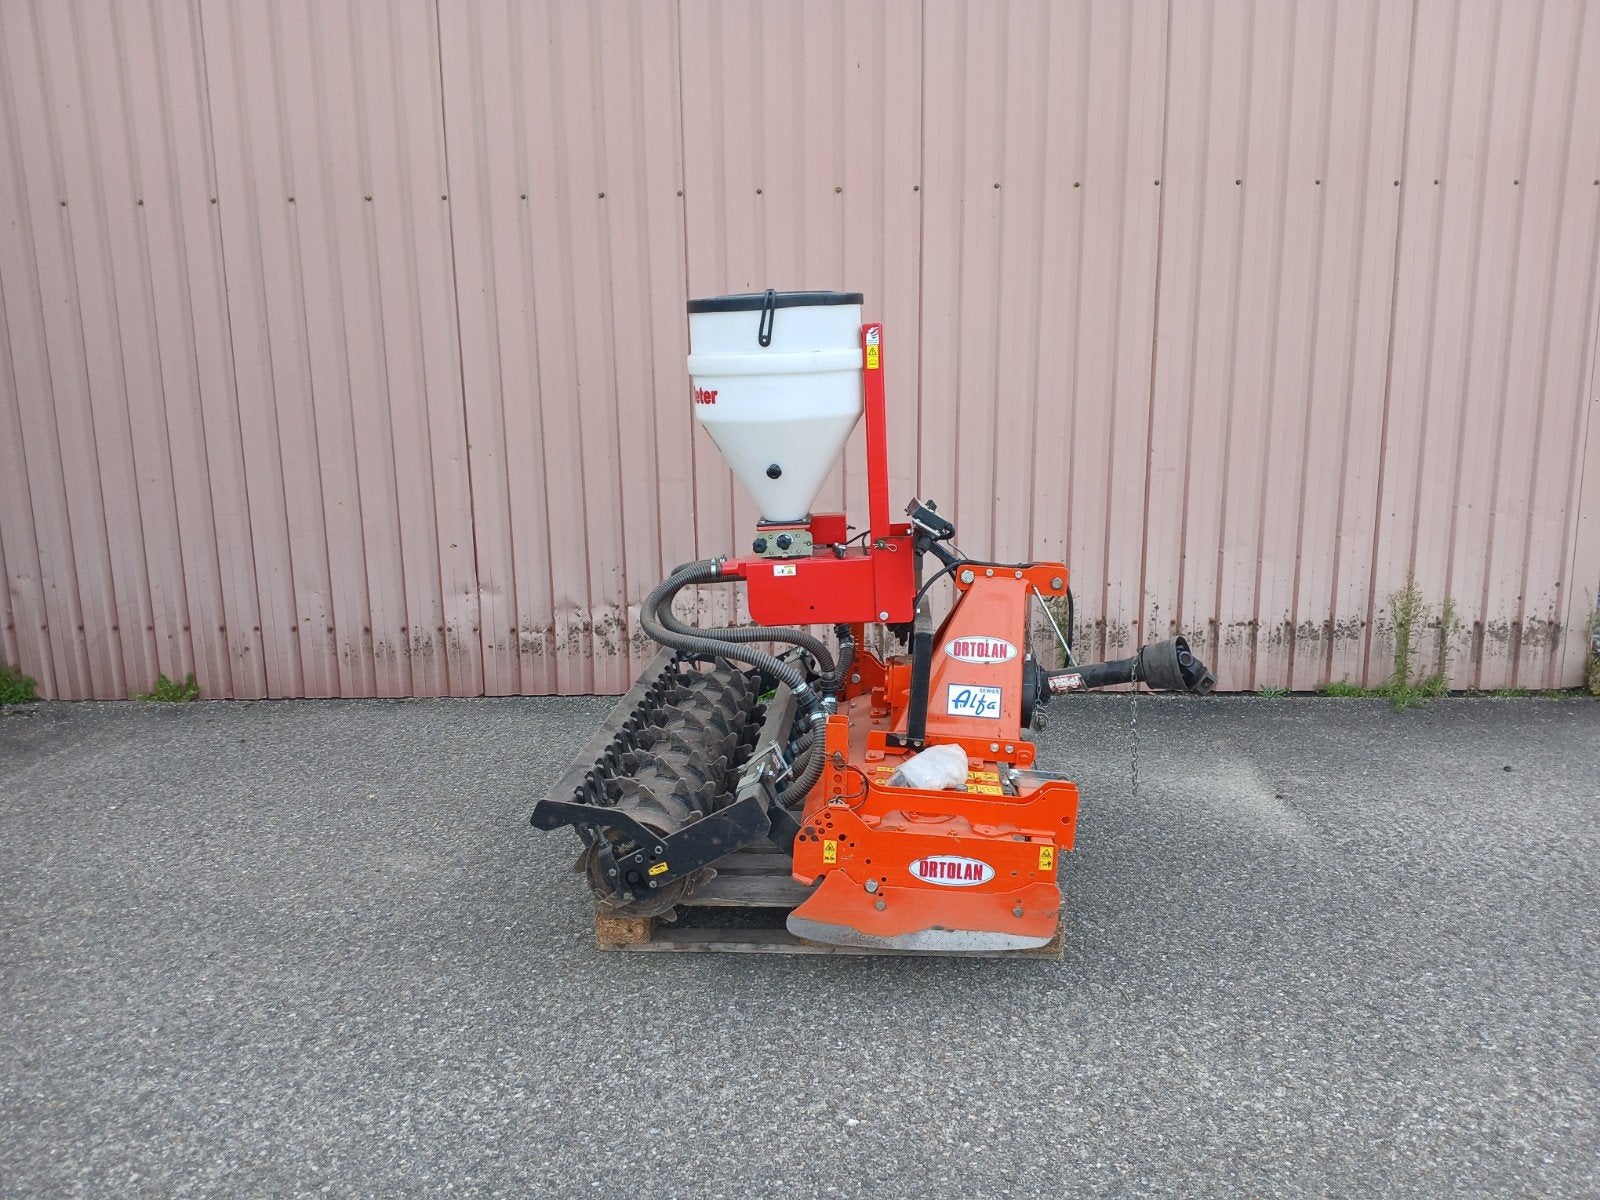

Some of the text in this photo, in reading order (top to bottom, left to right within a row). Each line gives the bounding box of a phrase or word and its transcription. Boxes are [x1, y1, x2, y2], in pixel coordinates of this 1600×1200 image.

[953, 641, 1008, 659] ORTOLAN
[951, 689, 997, 716] Alfa
[919, 860, 984, 881] ORTOLAN
